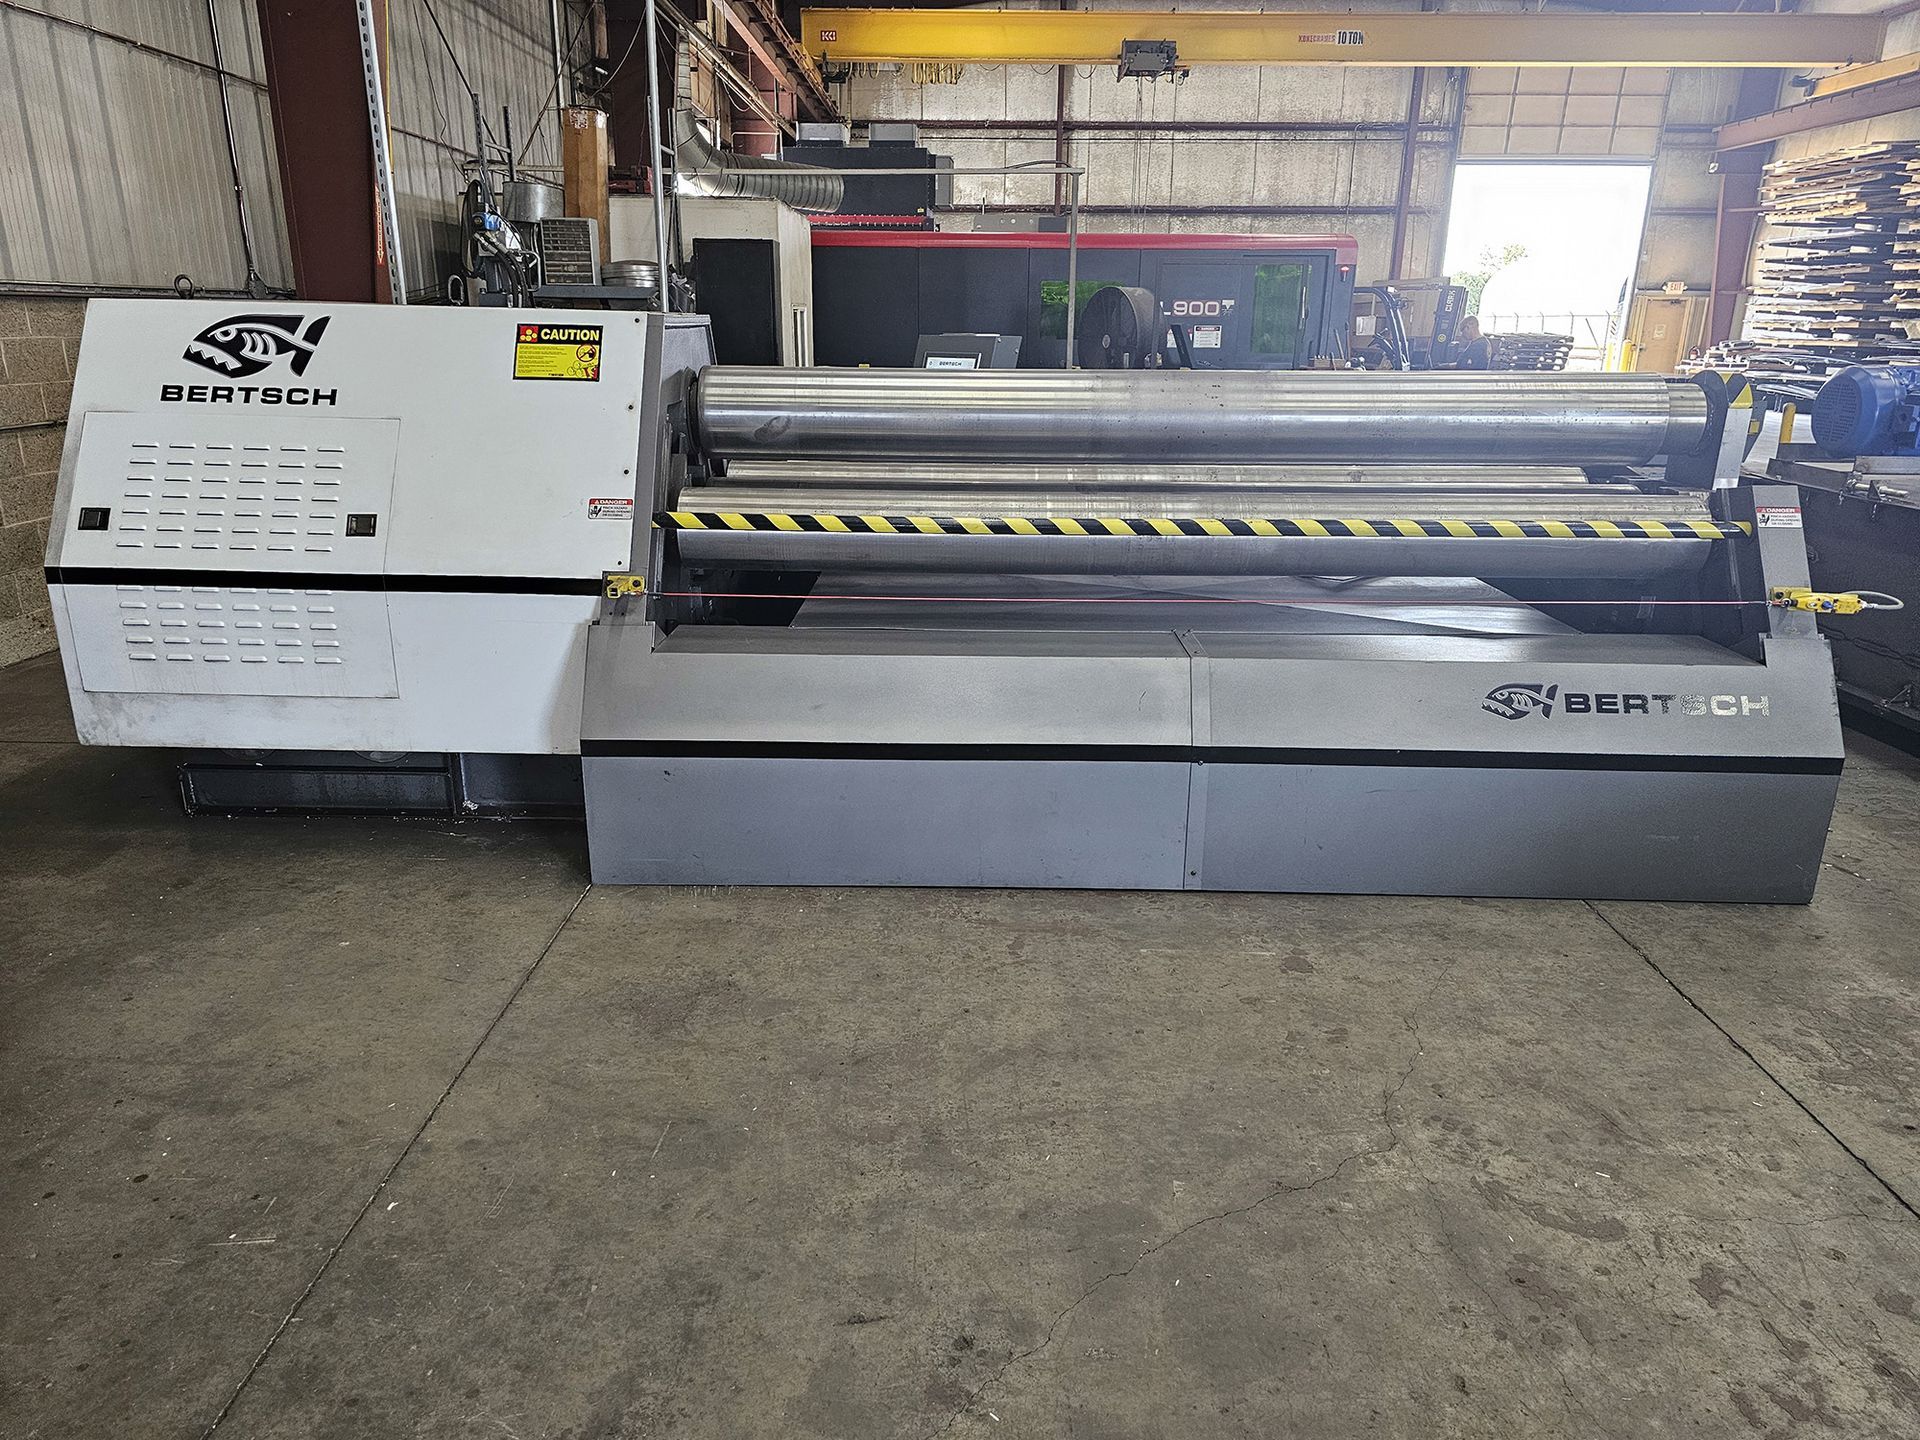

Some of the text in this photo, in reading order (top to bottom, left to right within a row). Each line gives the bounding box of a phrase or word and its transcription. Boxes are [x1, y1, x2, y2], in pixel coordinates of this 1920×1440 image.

[1338, 31, 1347, 45] 10
[1349, 31, 1364, 45] TON
[1670, 282, 1682, 290] EXIT
[540, 328, 600, 341] CAUTION
[160, 384, 338, 406] BERTSCH
[1564, 693, 1769, 717] BERTSCH
